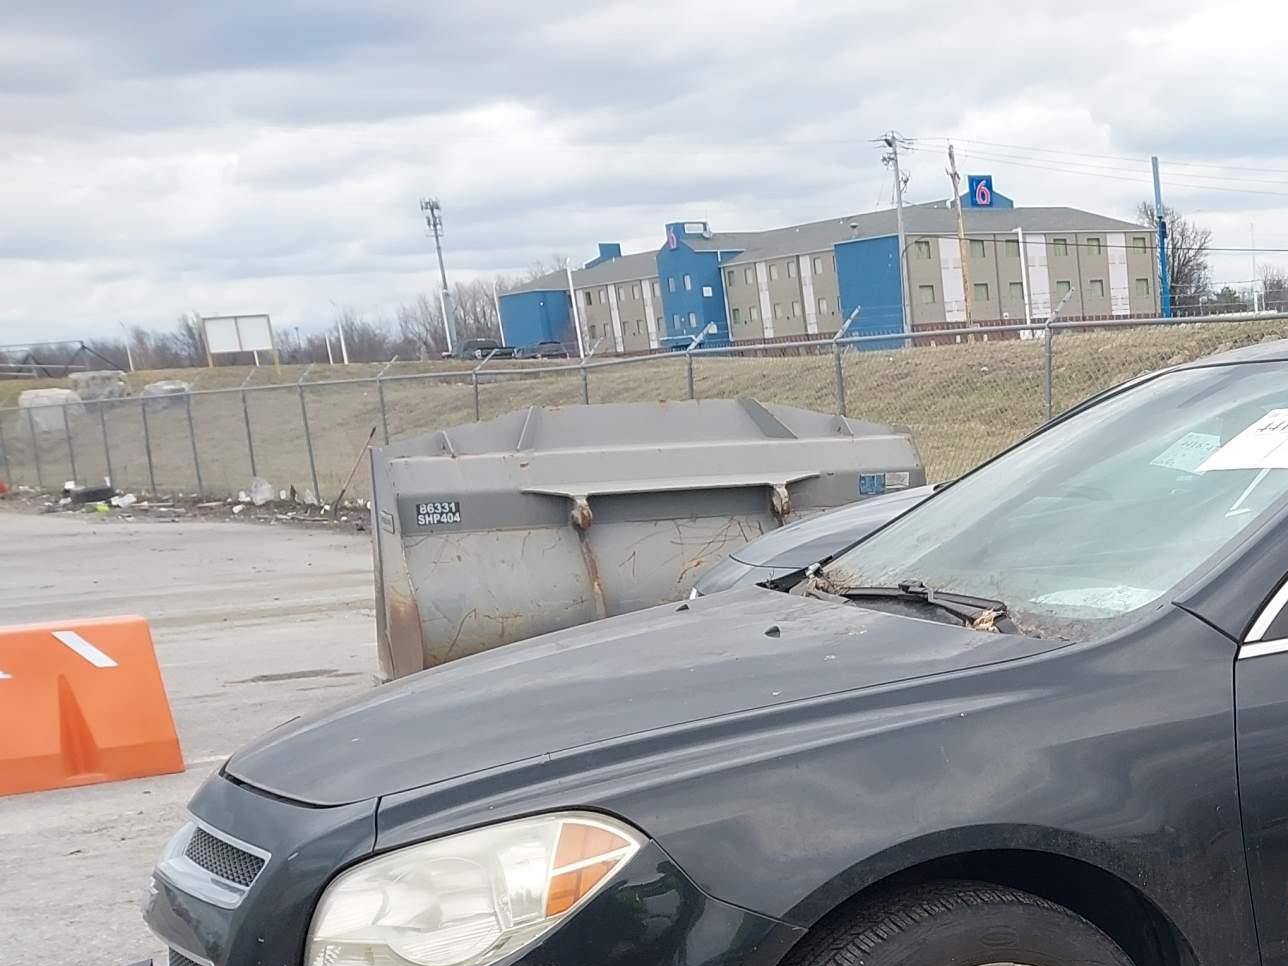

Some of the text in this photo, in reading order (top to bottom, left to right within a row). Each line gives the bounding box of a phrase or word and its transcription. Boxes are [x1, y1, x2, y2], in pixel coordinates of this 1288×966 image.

[976, 180, 991, 205] 6
[420, 502, 455, 514] 86331
[418, 512, 461, 525] SHP404
